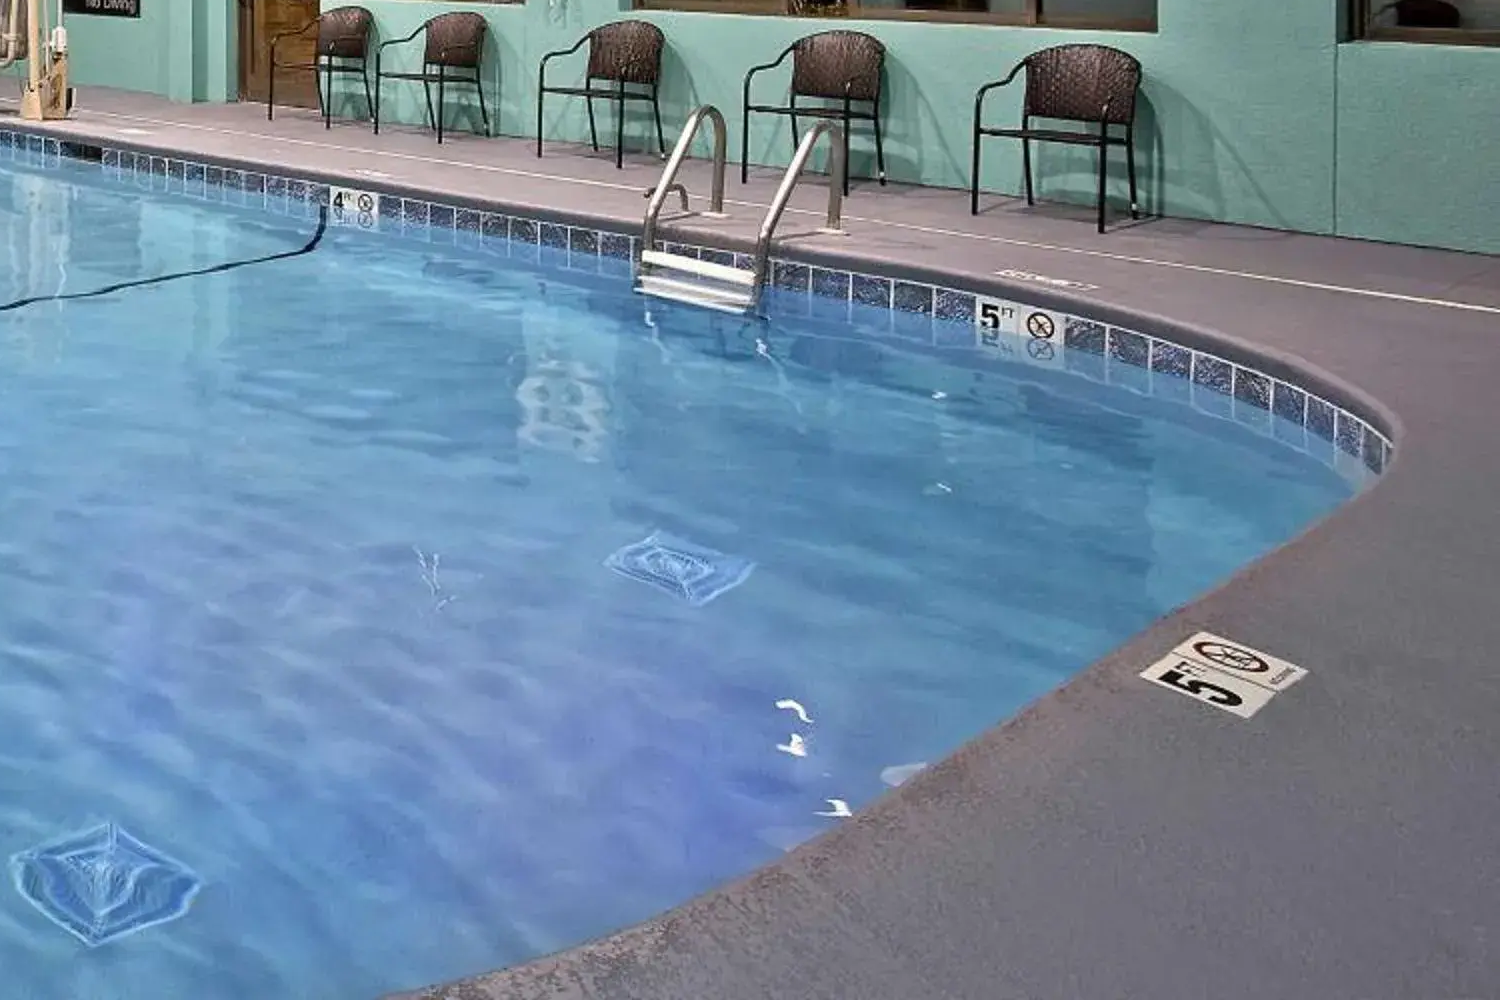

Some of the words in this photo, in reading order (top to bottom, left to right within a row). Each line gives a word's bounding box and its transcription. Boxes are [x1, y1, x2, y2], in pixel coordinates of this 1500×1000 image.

[333, 191, 344, 208] 4
[981, 303, 999, 329] 5
[1158, 669, 1243, 707] 5
